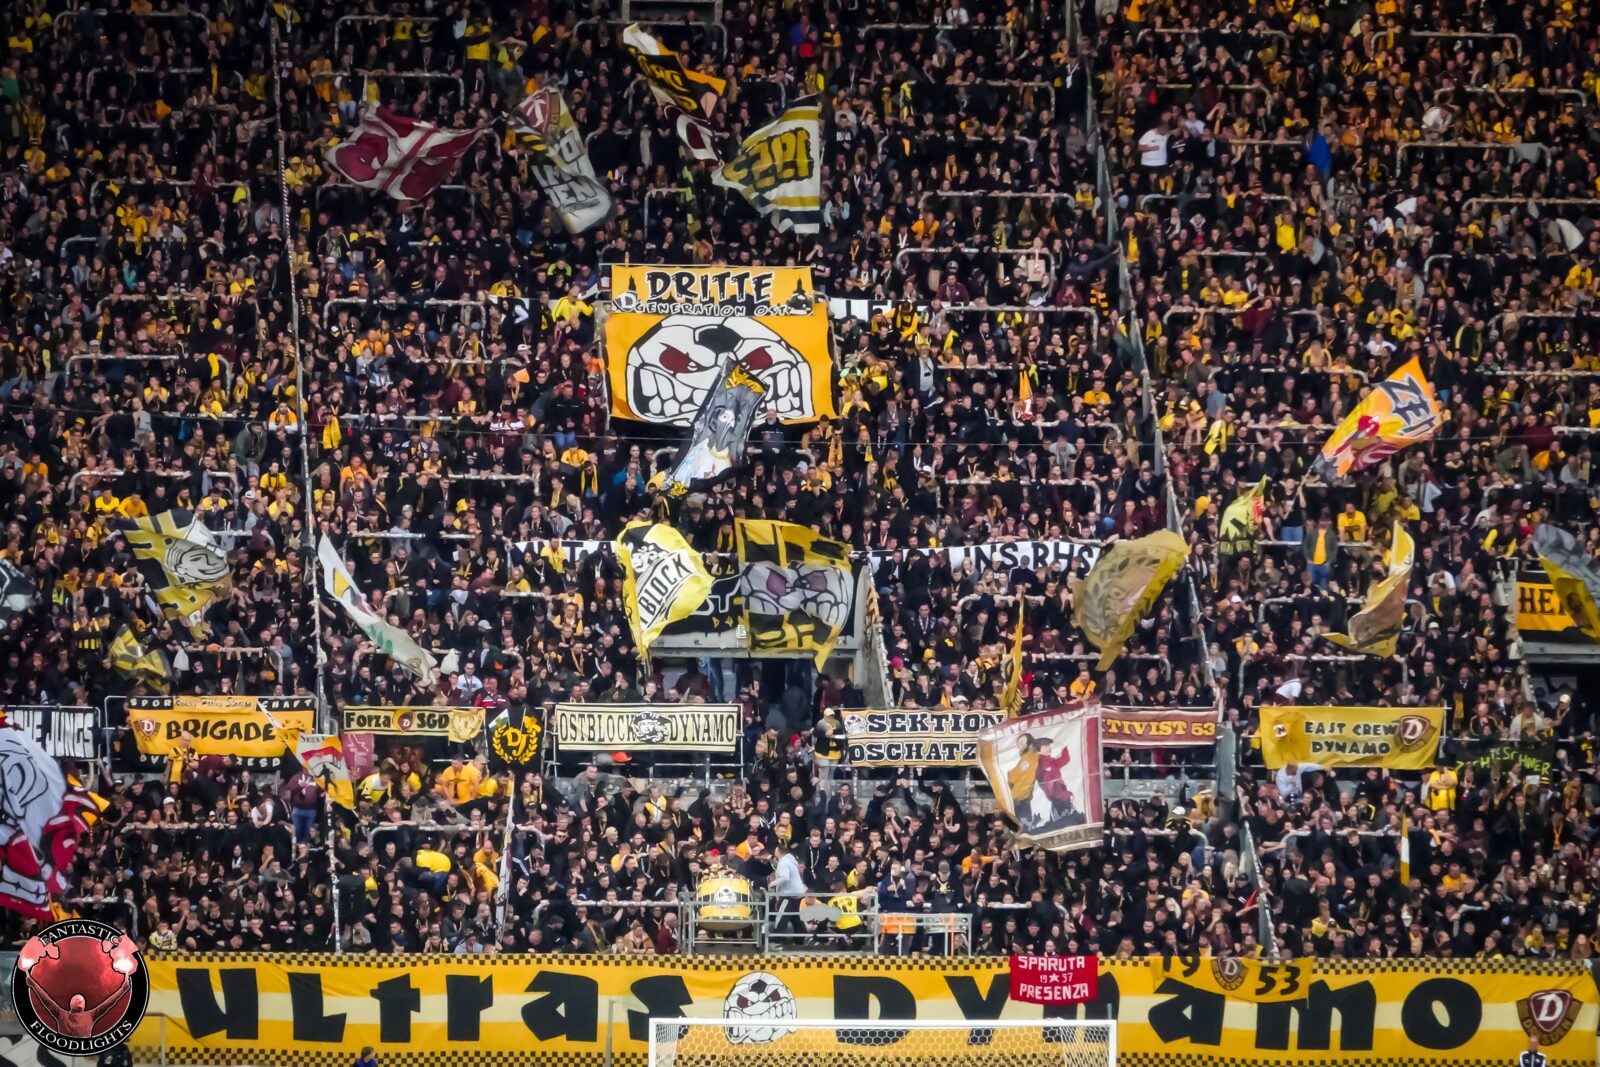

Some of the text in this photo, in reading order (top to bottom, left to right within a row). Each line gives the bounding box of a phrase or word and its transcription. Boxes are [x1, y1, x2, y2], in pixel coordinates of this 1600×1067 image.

[647, 271, 774, 302] DRITTE
[636, 303, 746, 316] GENERATION
[1031, 542, 1094, 575] RHS
[345, 712, 391, 729] Forza
[416, 712, 450, 729] SGD
[559, 712, 735, 743] OSTBLOCK DYNAMO
[867, 713, 1005, 733] SEKTION
[1101, 719, 1187, 736] TIVIST
[1191, 722, 1216, 736] 53
[1304, 721, 1398, 736] EAST CREW
[45, 711, 94, 758] JUNGS
[166, 719, 276, 742] BRIGADE
[850, 743, 977, 761] OSCHATZ
[1311, 740, 1391, 755] DYNAMO
[1017, 956, 1085, 971] SPARUTA
[1255, 966, 1302, 996] 53
[1019, 983, 1089, 1001] PRESENZA
